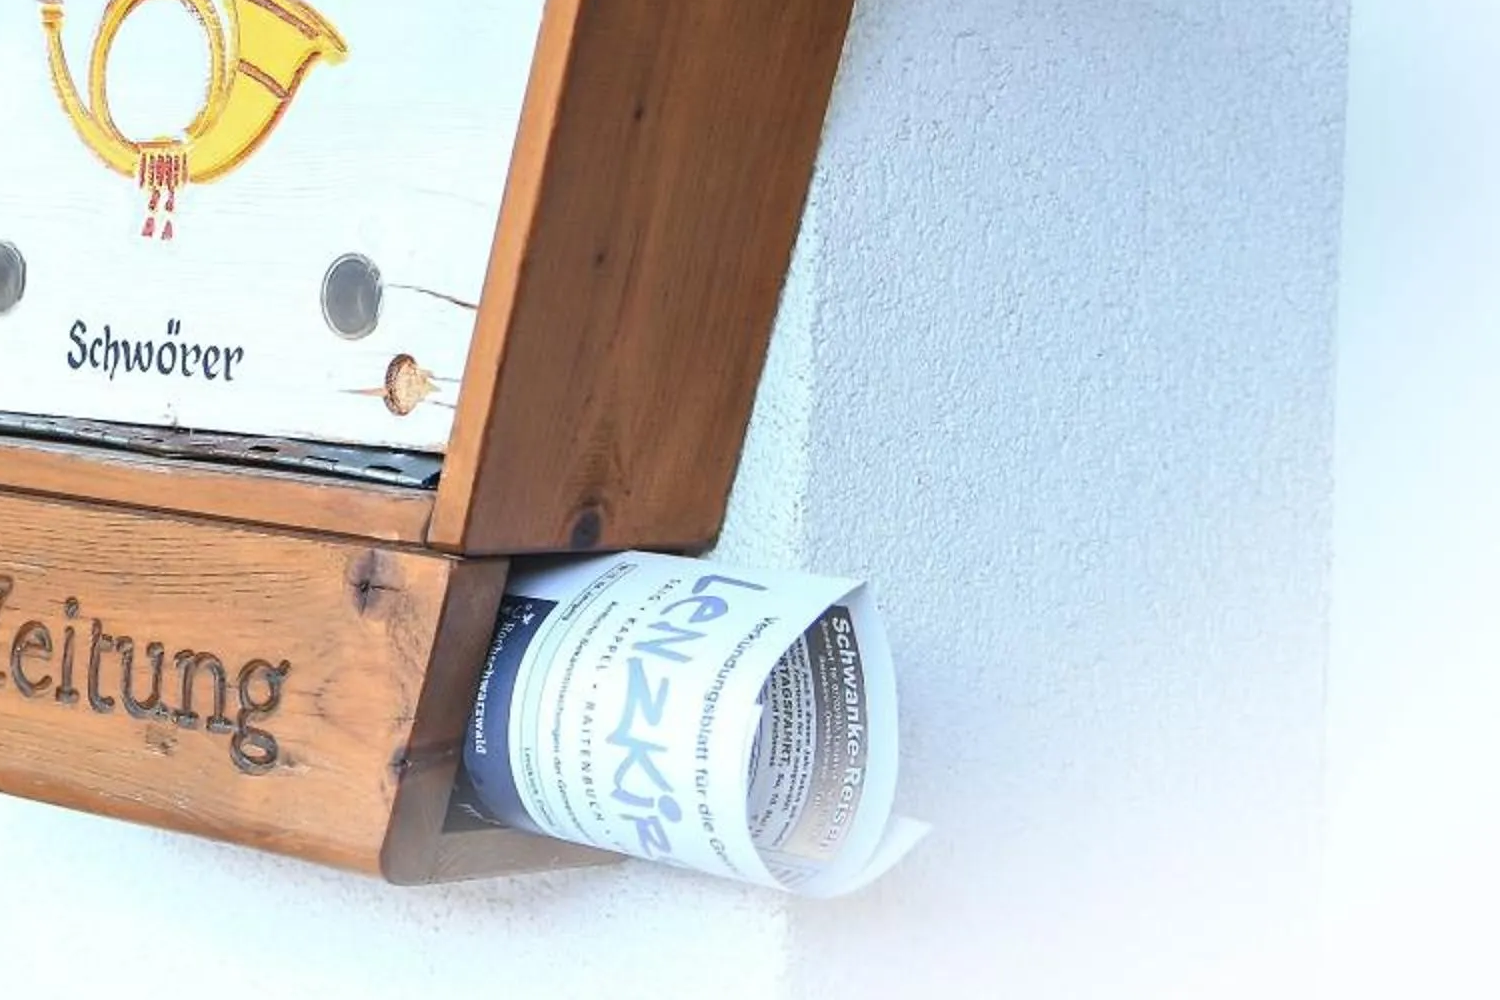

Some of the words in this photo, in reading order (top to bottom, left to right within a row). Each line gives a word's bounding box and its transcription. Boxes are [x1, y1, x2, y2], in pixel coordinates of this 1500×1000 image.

[67, 320, 245, 381] Schwörer
[474, 621, 516, 755] Hochschwarzwald
[818, 615, 863, 852] Schwanke-Reisen
[695, 767, 710, 796] für
[697, 803, 716, 833] die
